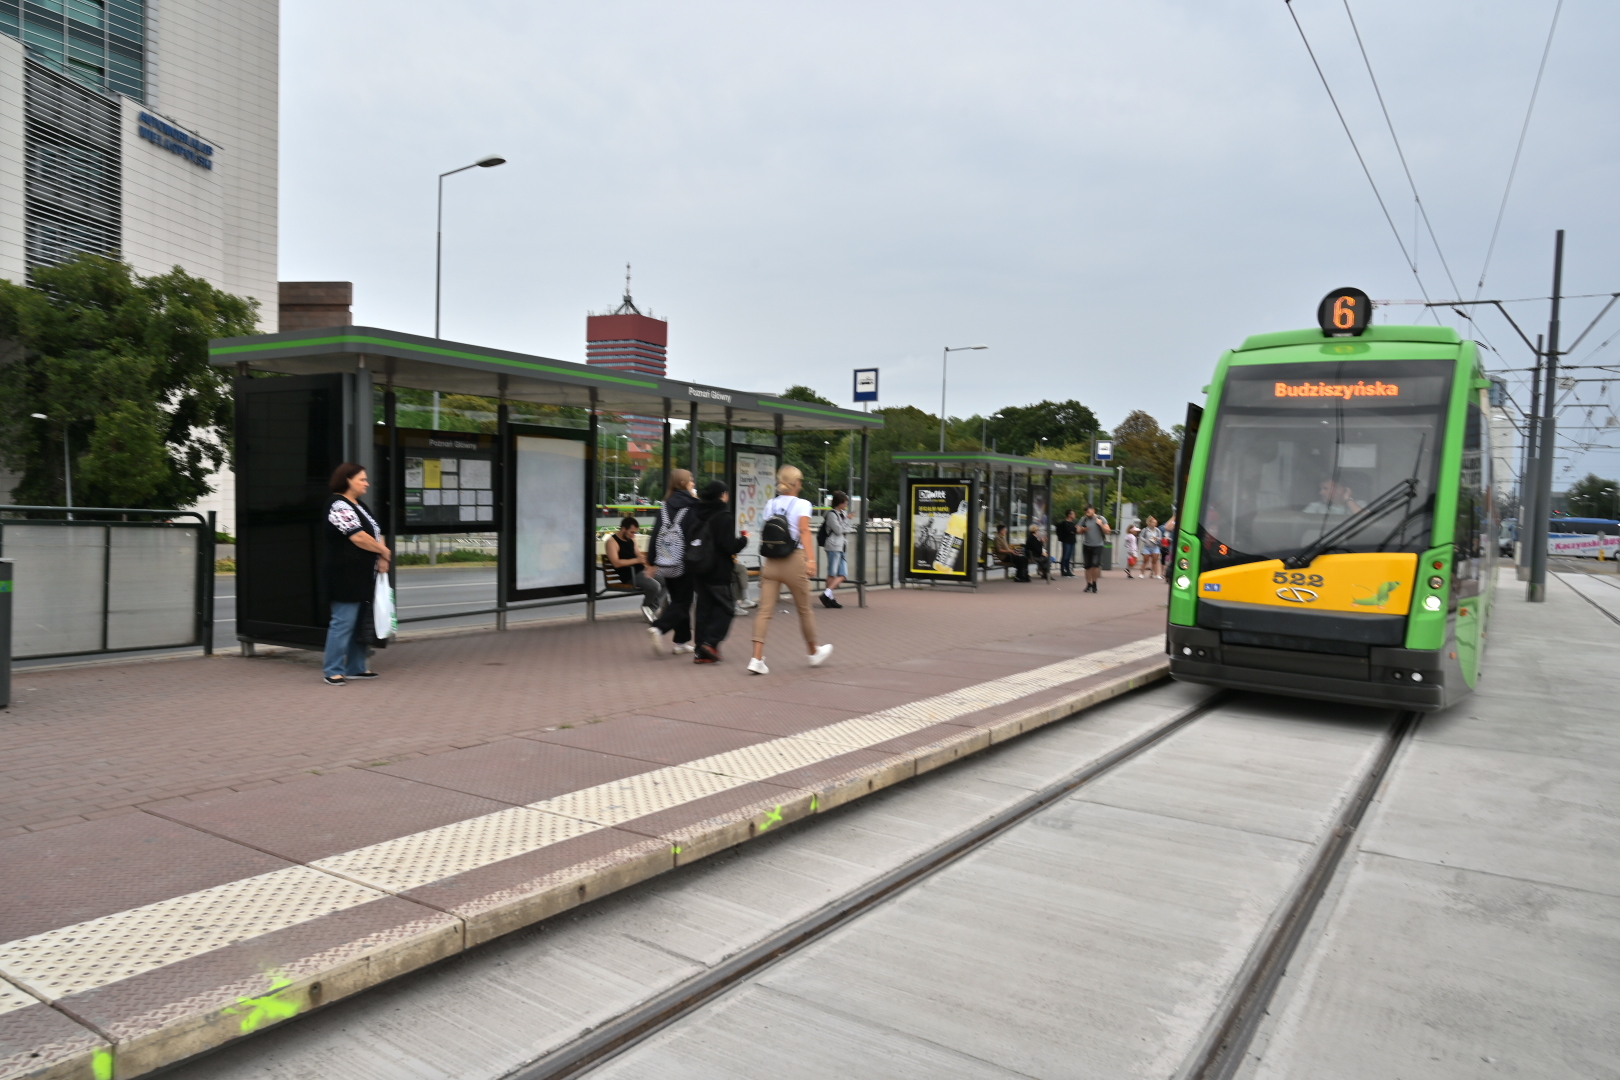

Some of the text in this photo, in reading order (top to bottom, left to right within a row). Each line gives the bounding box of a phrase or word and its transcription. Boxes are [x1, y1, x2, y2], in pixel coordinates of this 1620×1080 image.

[1333, 296, 1356, 329] 6
[688, 386, 732, 403] Poznań Główny
[1274, 381, 1399, 400] Budziszyńska
[428, 438, 453, 448] Poznań
[1218, 544, 1229, 555] 3
[1273, 571, 1324, 587] 522
